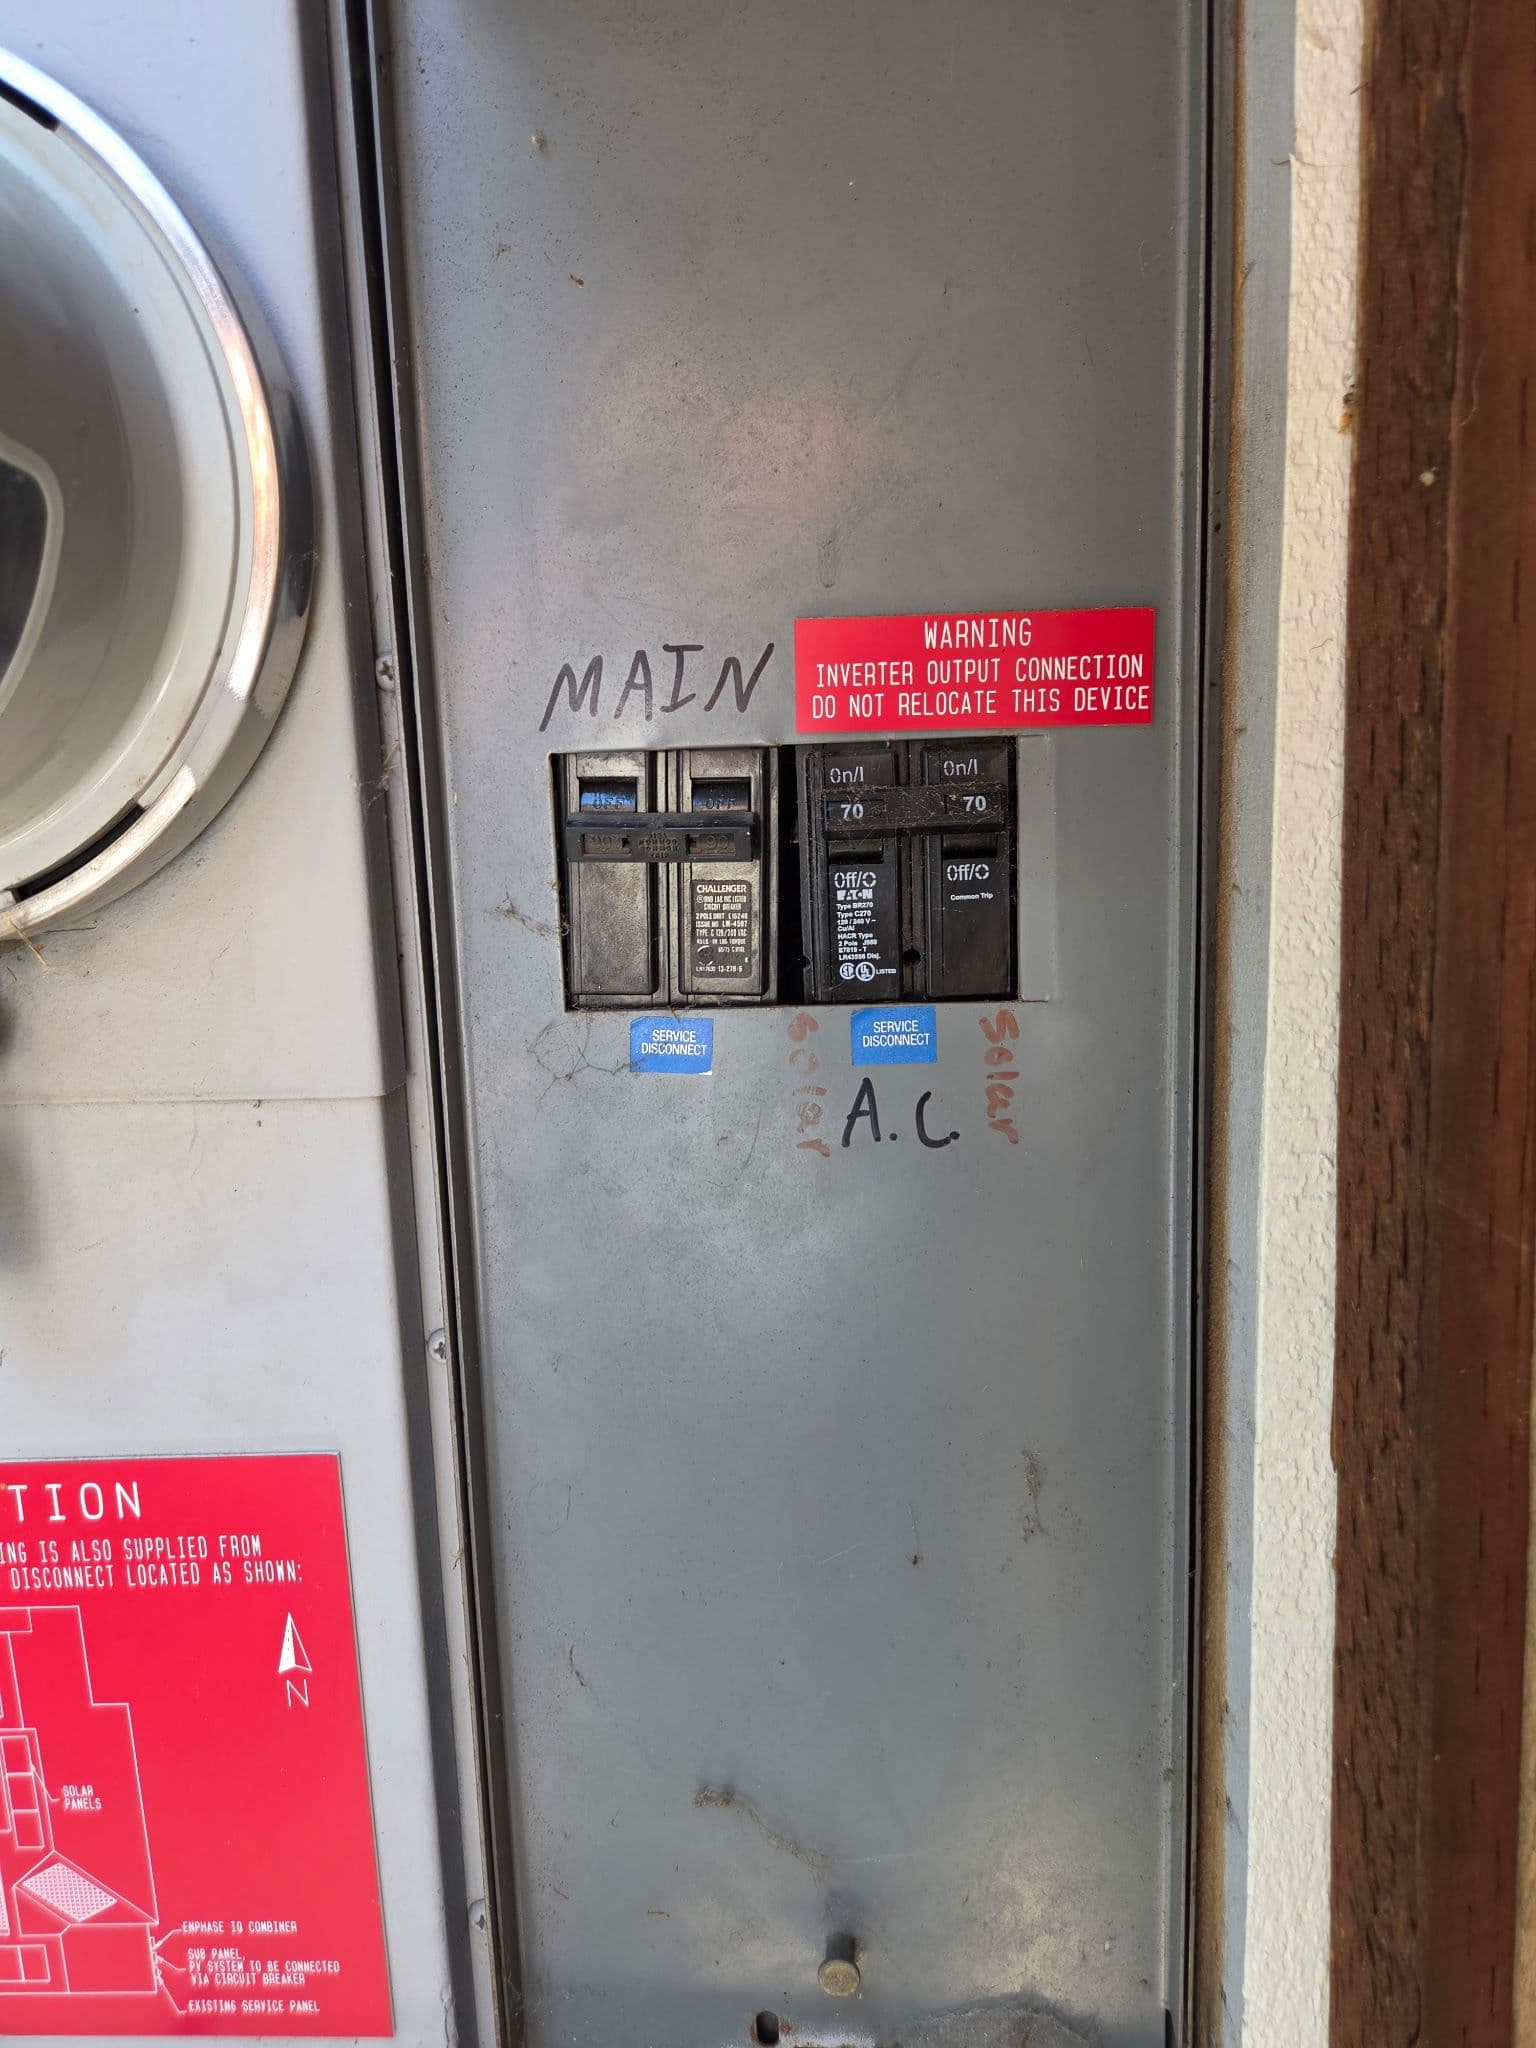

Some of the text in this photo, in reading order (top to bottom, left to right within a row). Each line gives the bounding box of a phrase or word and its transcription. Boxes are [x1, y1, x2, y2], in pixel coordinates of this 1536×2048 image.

[924, 618, 1032, 650] WARNING
[815, 654, 1144, 688] INVERTER OUTPUT CONNECTION
[539, 643, 774, 732] MAIN
[812, 685, 1149, 719] DO NOT RELOCATE THIS DEVICE
[963, 796, 986, 811] 70
[841, 804, 863, 819] 70
[696, 884, 747, 893] CHALLENGER
[950, 892, 993, 901] Common Trip
[854, 910, 872, 918] C270
[873, 1020, 919, 1034] SERVICE
[652, 1030, 696, 1042] SERVICE
[862, 1034, 930, 1048] DISCONNECT
[641, 1042, 708, 1056] DISCONNECT
[39, 1540, 59, 1562] IS
[72, 1539, 112, 1562] ALSO
[124, 1536, 208, 1560] SUPPLIED
[218, 1534, 262, 1557] FROM
[11, 1560, 303, 1589] DISCONNECT LOCATED AS SHOWN:
[287, 1680, 310, 1707] N
[62, 1784, 94, 1797] SOLAR
[64, 1797, 102, 1810] PANELS
[182, 1920, 224, 1933] ENPHASE
[248, 1920, 298, 1933] COMBINER
[187, 1948, 206, 1960] SUB
[188, 1960, 340, 1972] PV SYSTEM TO BE CONNECTED
[191, 1972, 306, 1985] VIA CIRCUIT BREAKER
[188, 2000, 320, 2012] EXISTING SERVICE PANEL
